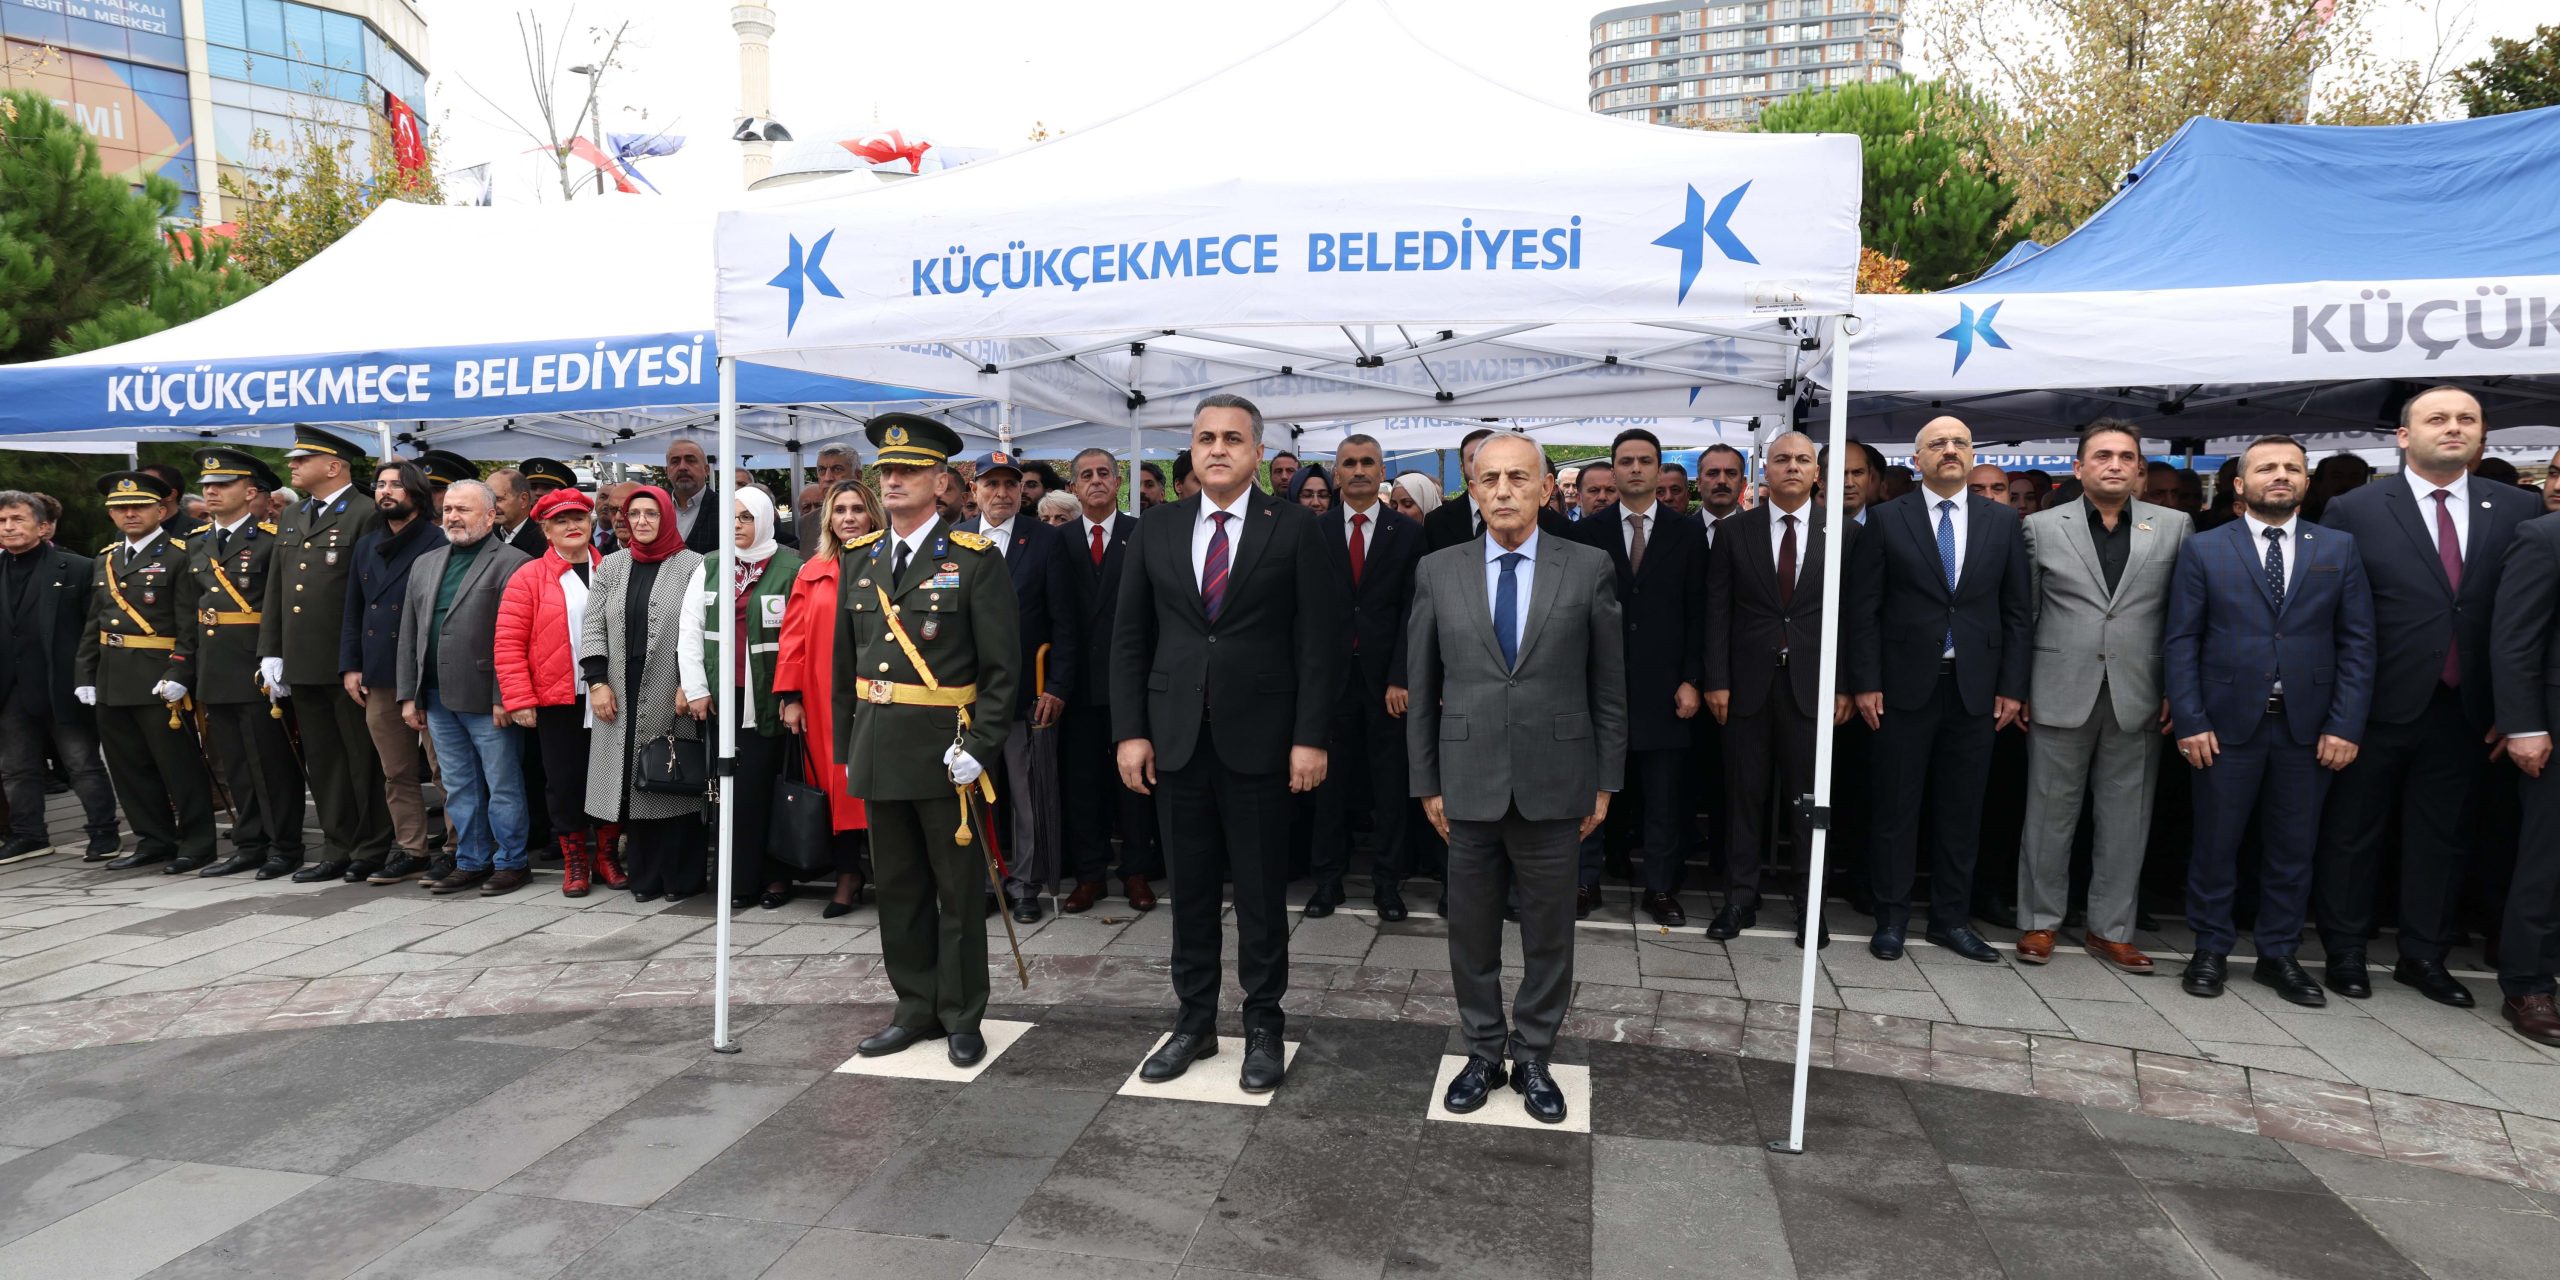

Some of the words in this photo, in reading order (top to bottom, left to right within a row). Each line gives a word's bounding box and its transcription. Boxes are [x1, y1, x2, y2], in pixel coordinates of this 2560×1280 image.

[94, 9, 167, 34] MERKEZİ
[49, 98, 124, 140] Mİ
[912, 235, 1278, 298] KÜÇÜKÇEKMECE
[1307, 215, 1582, 273] BELEDİYESİ
[108, 364, 430, 416] KÜÇÜKÇEKMECE
[455, 335, 702, 398] BELEDİYESİ
